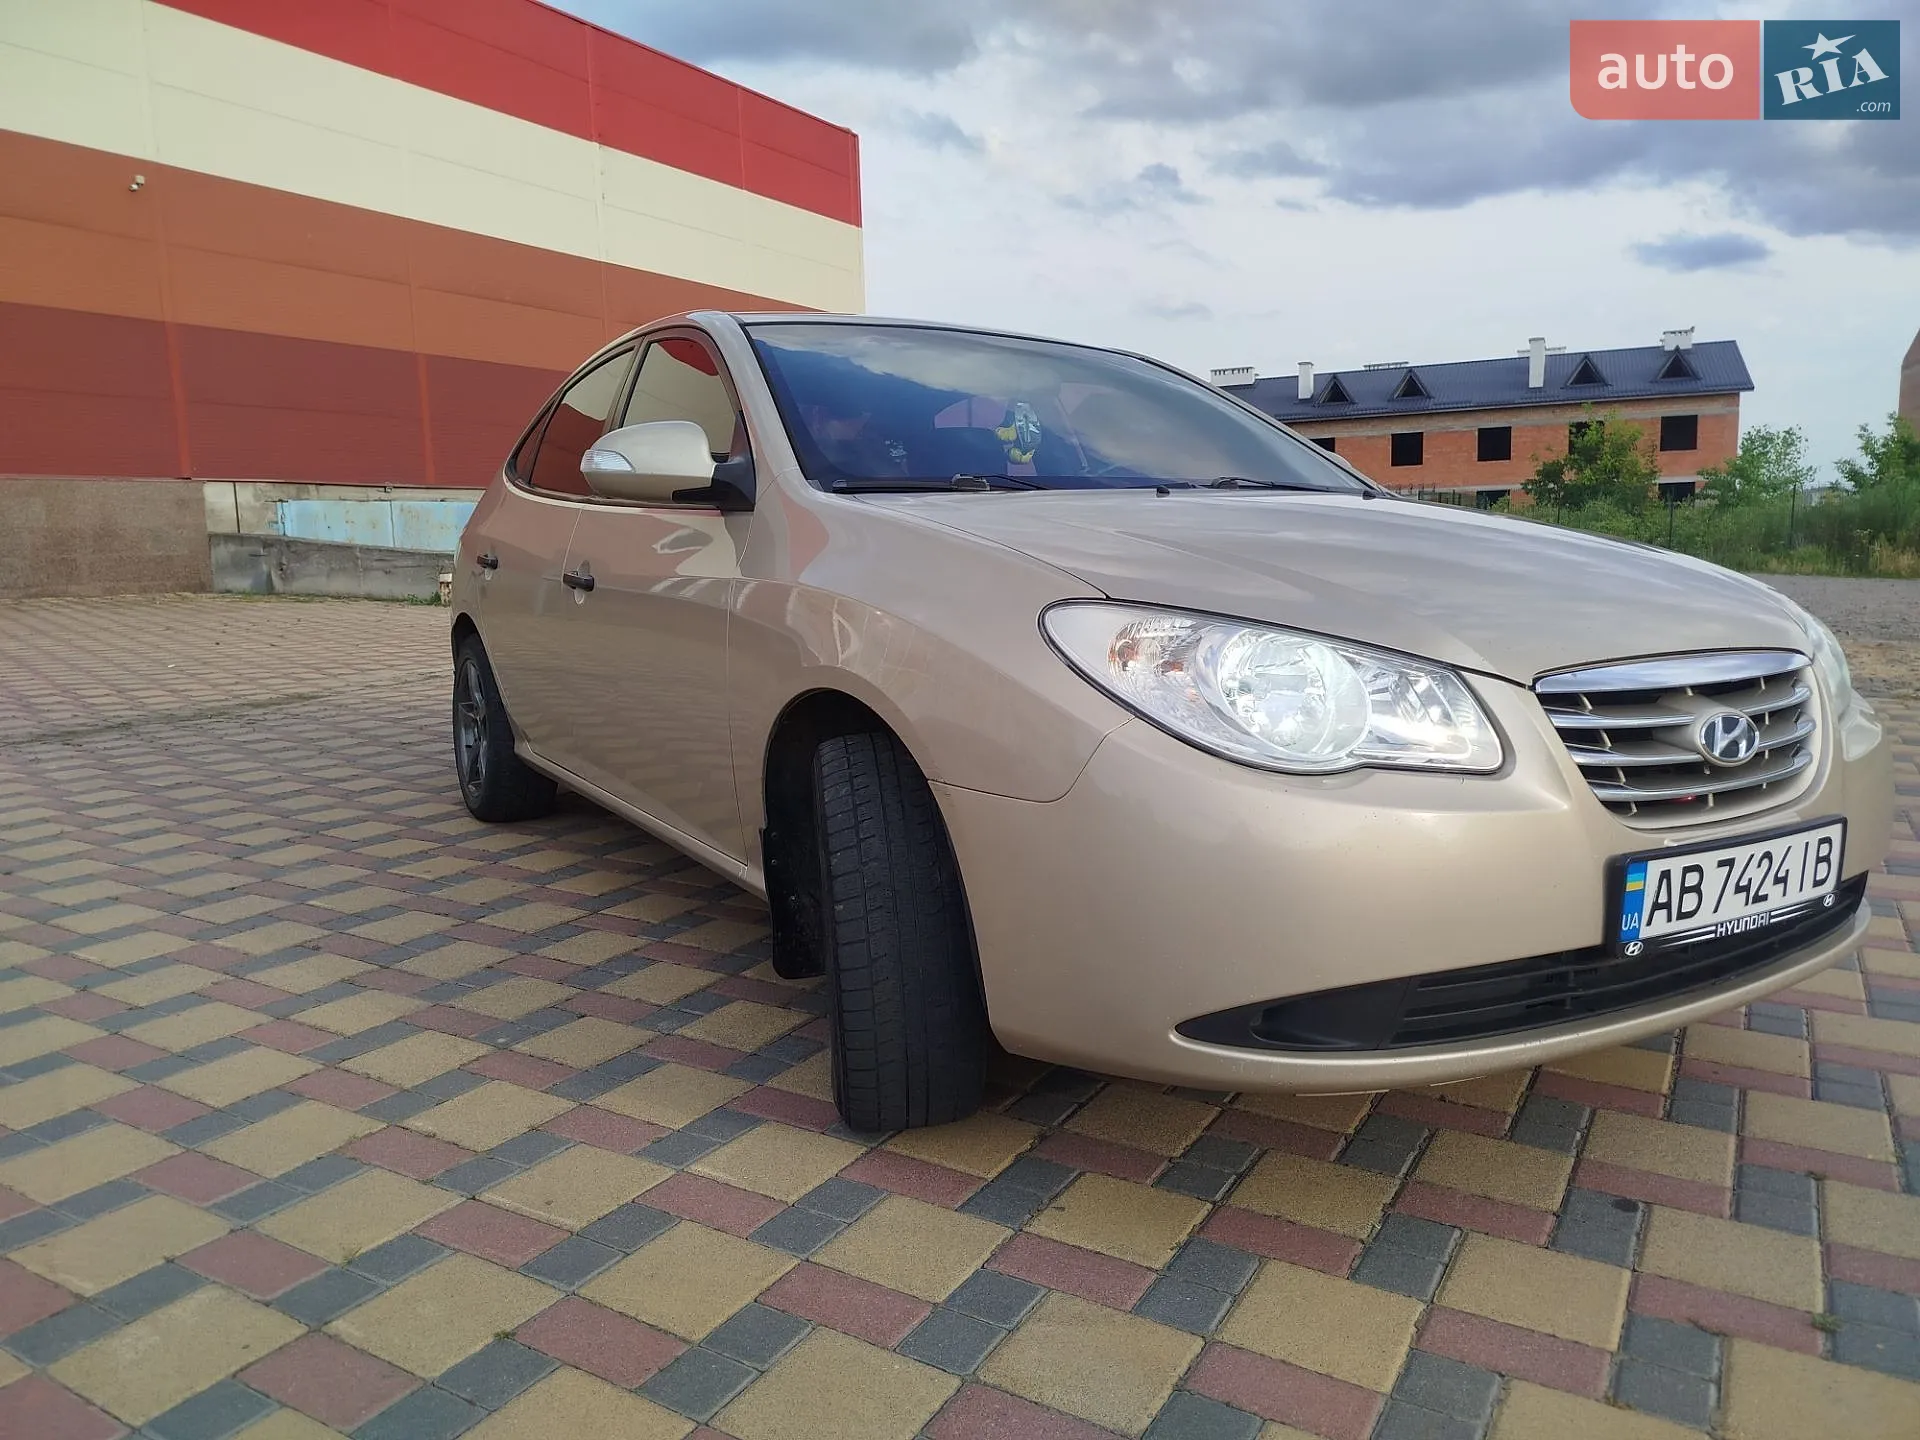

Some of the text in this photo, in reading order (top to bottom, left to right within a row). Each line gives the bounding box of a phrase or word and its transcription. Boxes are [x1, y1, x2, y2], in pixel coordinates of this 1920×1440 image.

[1646, 836, 1833, 927] AB 7424 IB
[1621, 913, 1640, 931] UA
[1716, 913, 1770, 937] HYUNDAI
